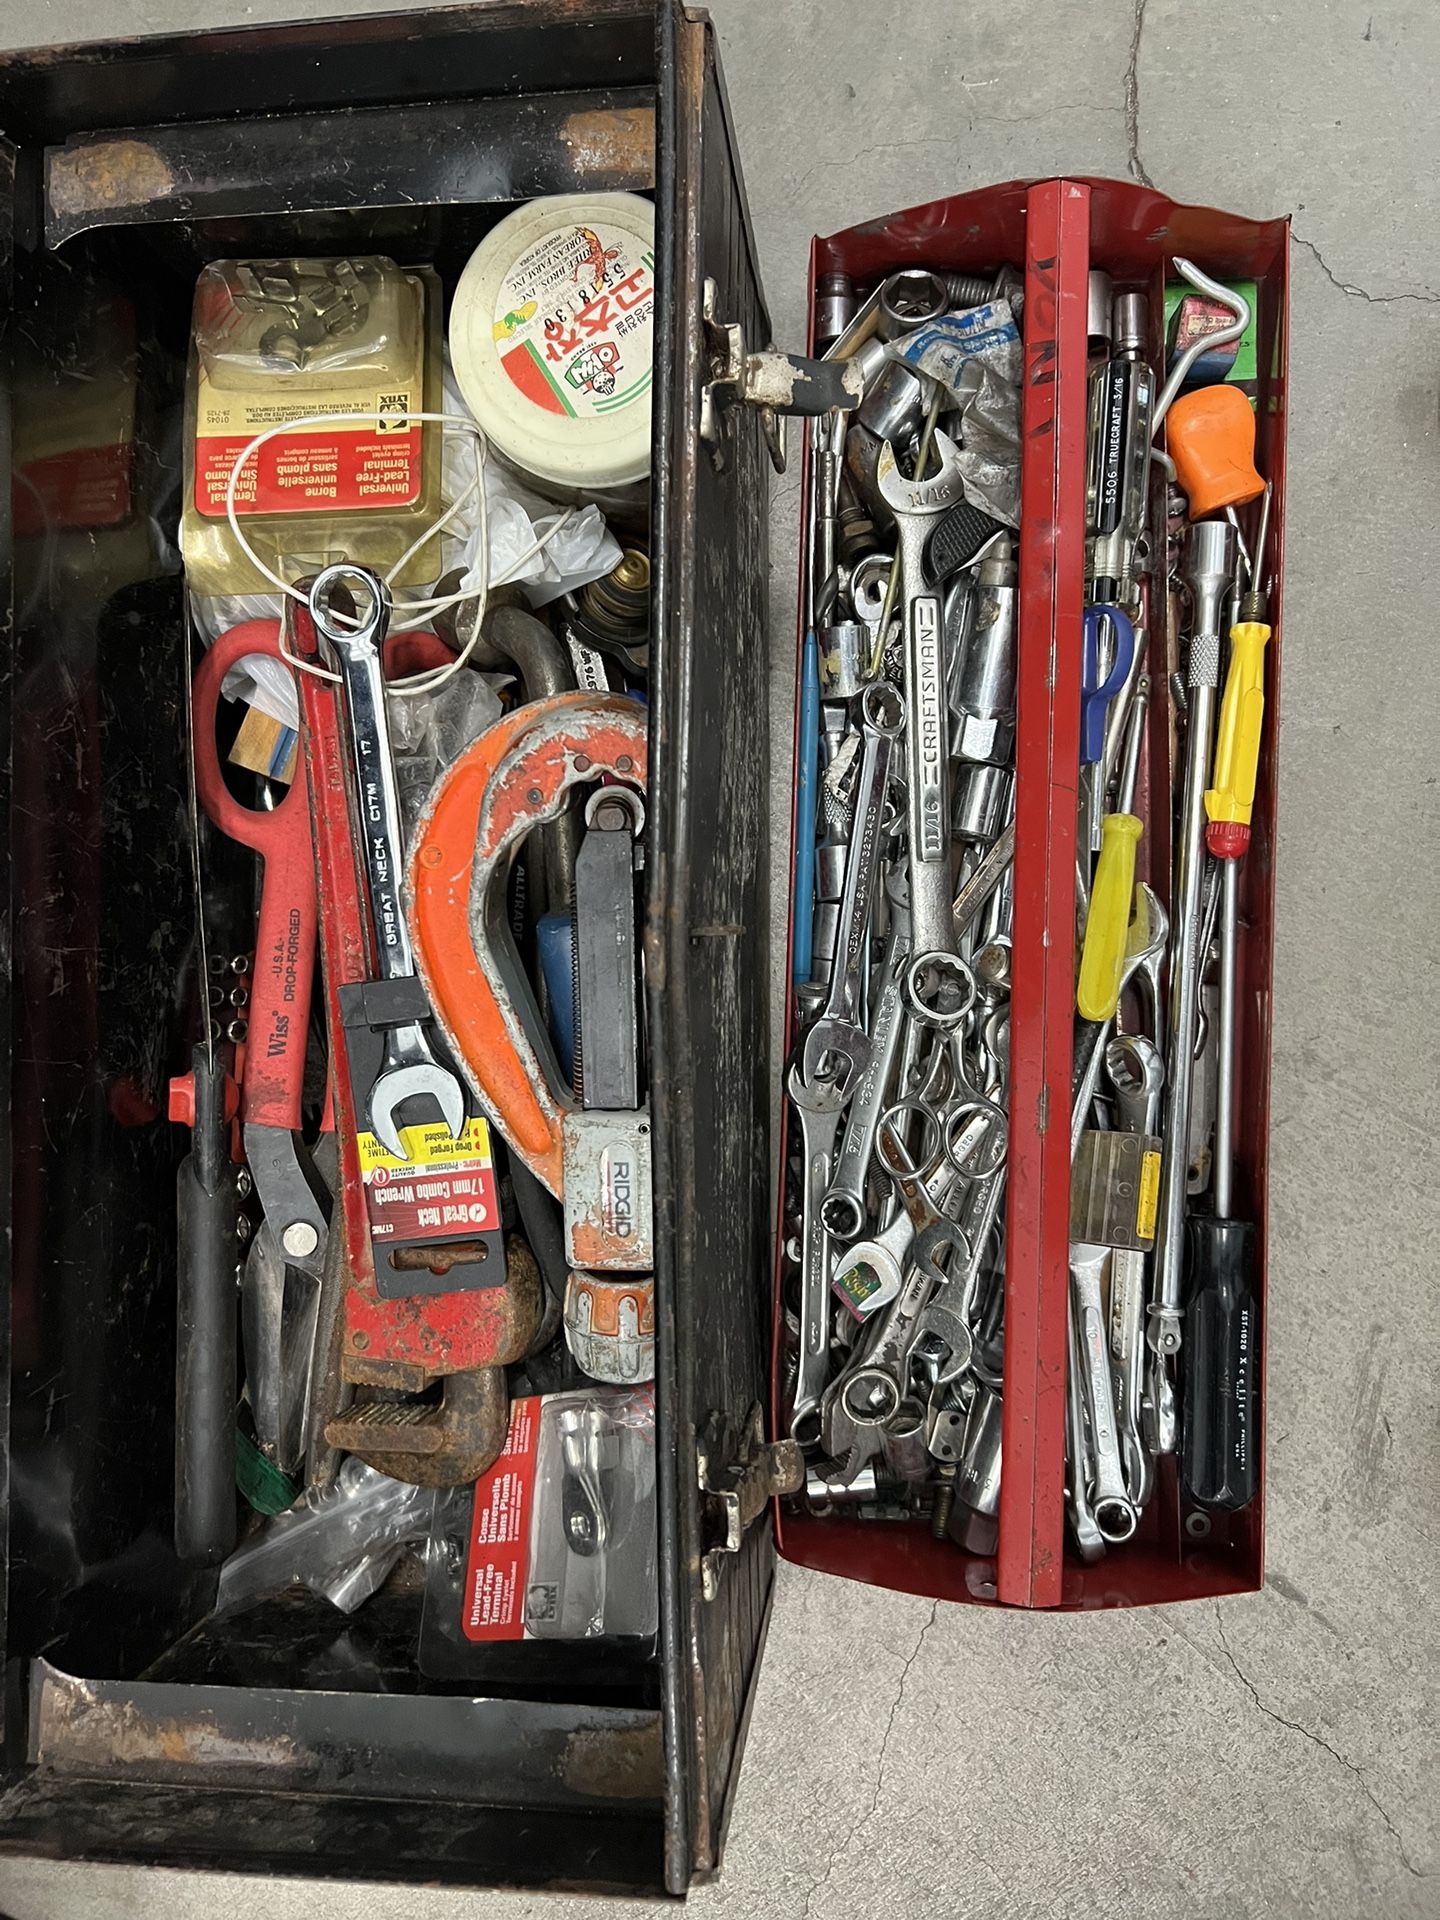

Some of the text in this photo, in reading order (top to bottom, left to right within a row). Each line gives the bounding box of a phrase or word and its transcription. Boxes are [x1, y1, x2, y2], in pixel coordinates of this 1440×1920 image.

[539, 233, 561, 251] PRODUCT
[518, 253, 534, 266] KOREA
[524, 256, 553, 280] FARM,
[564, 245, 594, 270] RHEE
[507, 276, 526, 293] INC.
[515, 286, 537, 305] INC.
[531, 261, 659, 368] 고추장
[379, 394, 407, 403] LYNX
[206, 415, 229, 423] 01045
[1104, 377, 1123, 503] 5506 TRUECRAFT 3/16
[204, 469, 257, 481] Sin lomo
[276, 461, 337, 474] sans plomb
[355, 470, 409, 482] Lead-Free
[363, 458, 409, 471] Terminal
[207, 480, 256, 492] Univrsal
[277, 475, 336, 486] universelle
[304, 486, 336, 497] Borne
[359, 482, 408, 495] Universal
[210, 491, 256, 504] Termnal
[908, 484, 951, 507] 11/16
[920, 629, 939, 849] 11/16 CRAFTSMAN
[360, 739, 397, 945] GREAT NECK C17M 17
[861, 805, 876, 857] 3273430
[283, 908, 301, 1002] DROP-FORGED
[870, 983, 899, 1053] STANLEY
[429, 1140, 472, 1155] Drop Forged
[424, 1161, 458, 1173] Professional
[462, 1159, 481, 1168] Metric
[373, 1176, 484, 1205] 17mm Combo Wrench
[613, 1162, 631, 1238] RIDGID
[417, 1203, 469, 1227] Great Neck
[487, 1476, 501, 1543] Universelle
[496, 1473, 511, 1542] Sans Plomb
[478, 1507, 489, 1543] Cosse
[470, 1568, 484, 1626] Universal
[480, 1563, 494, 1625] Lead-Free
[489, 1571, 503, 1625] Terminal
[500, 1578, 511, 1624] Crimp Eyelet
